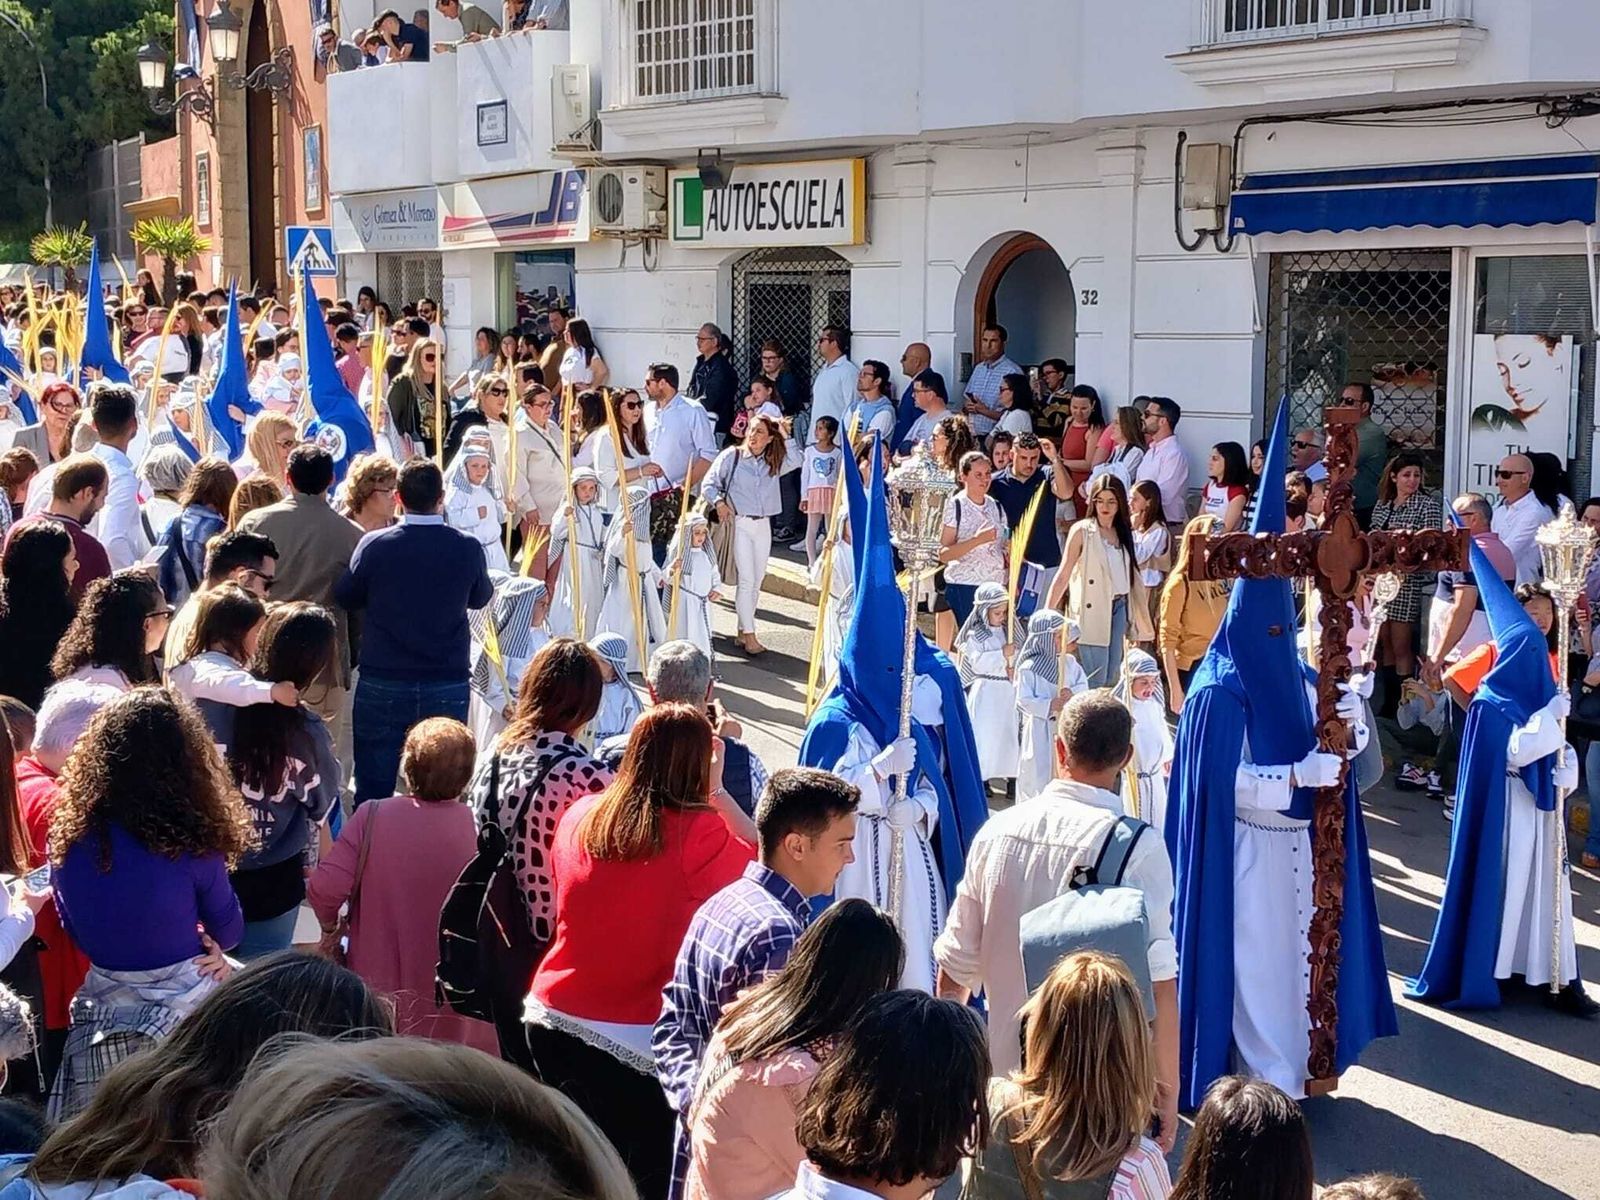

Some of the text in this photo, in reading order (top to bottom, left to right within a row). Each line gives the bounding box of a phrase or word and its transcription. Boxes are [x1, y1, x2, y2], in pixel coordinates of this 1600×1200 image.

[374, 199, 437, 225] Gómez & Moreno
[707, 178, 845, 232] AUTOESCUELA
[1081, 289, 1099, 306] 32
